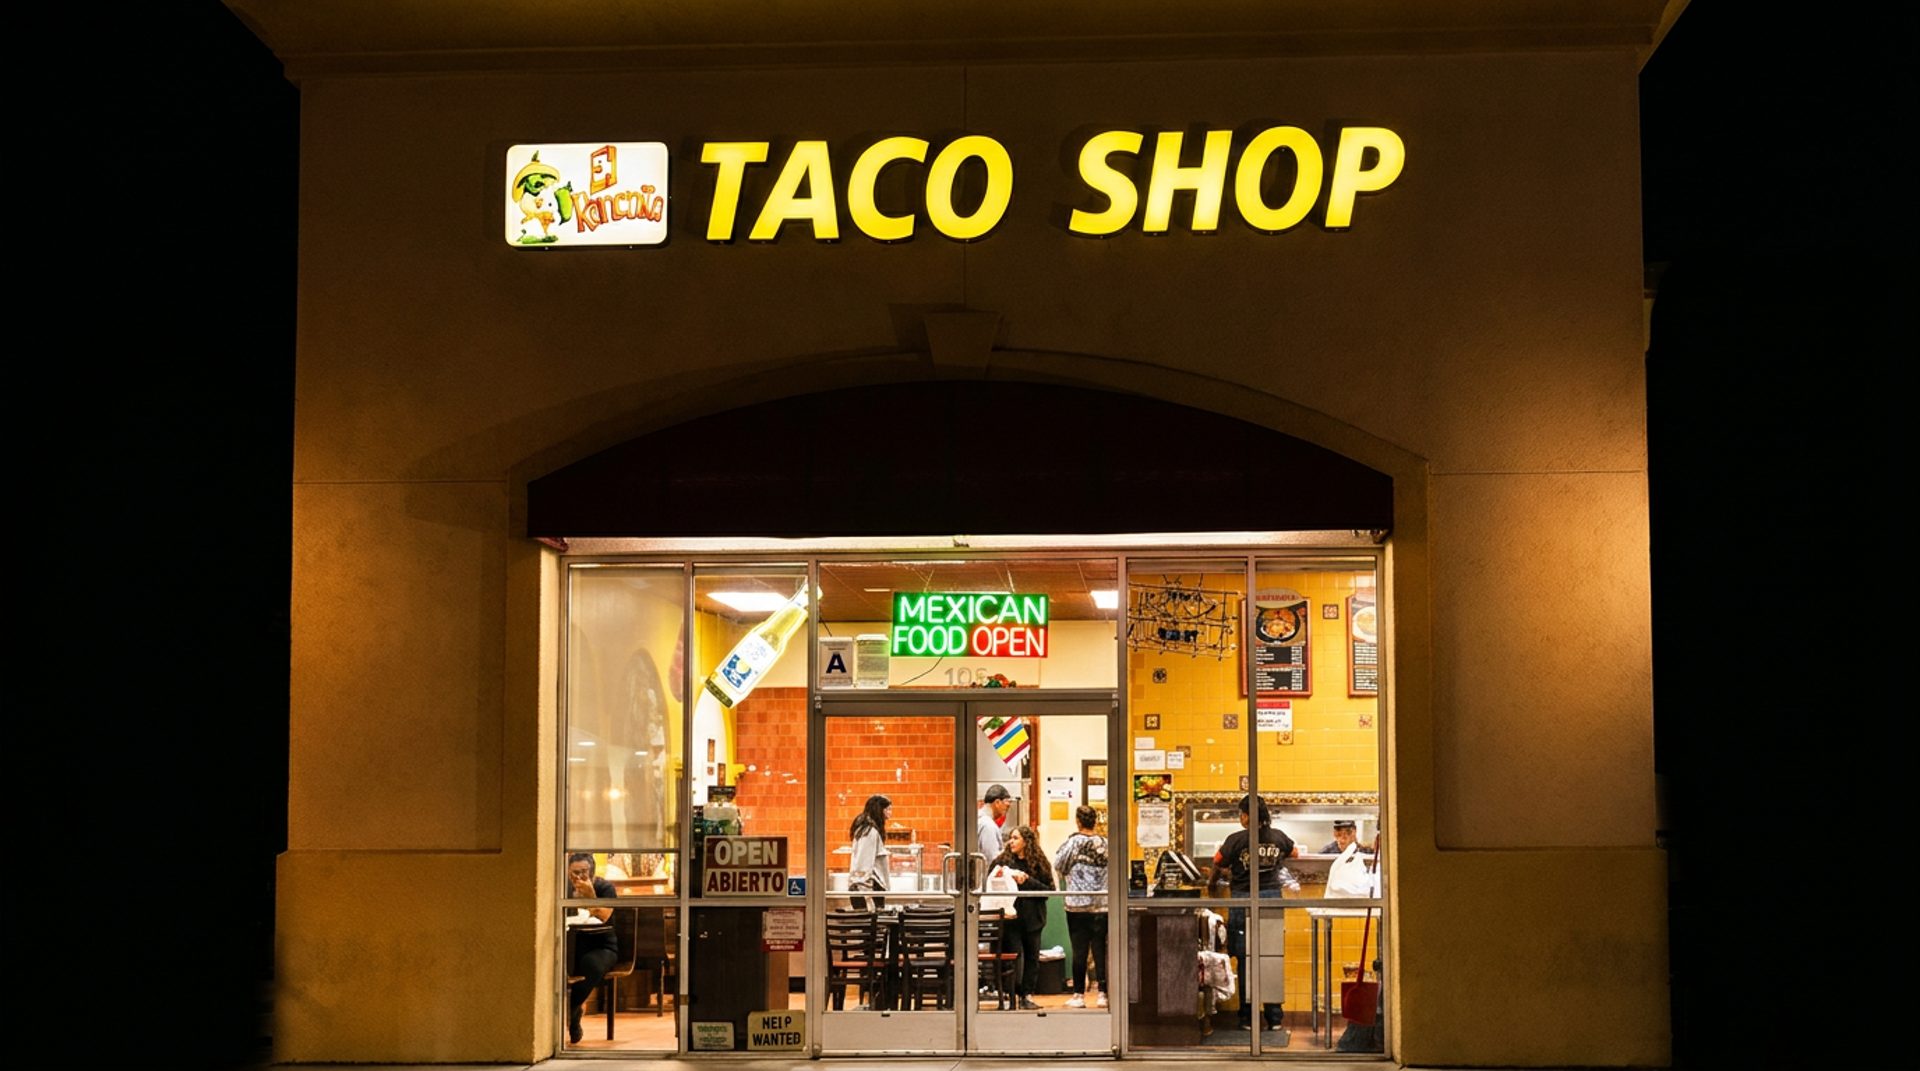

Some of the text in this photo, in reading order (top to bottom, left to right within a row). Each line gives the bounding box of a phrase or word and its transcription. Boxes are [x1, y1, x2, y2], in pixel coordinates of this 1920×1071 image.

[700, 125, 1406, 241] TACO SHOP
[899, 595, 1046, 624] MEXICAN
[892, 625, 1045, 656] FOOD OPEN
[826, 652, 847, 674] A
[714, 840, 778, 865] OPEN
[707, 871, 784, 892] ABIERTO
